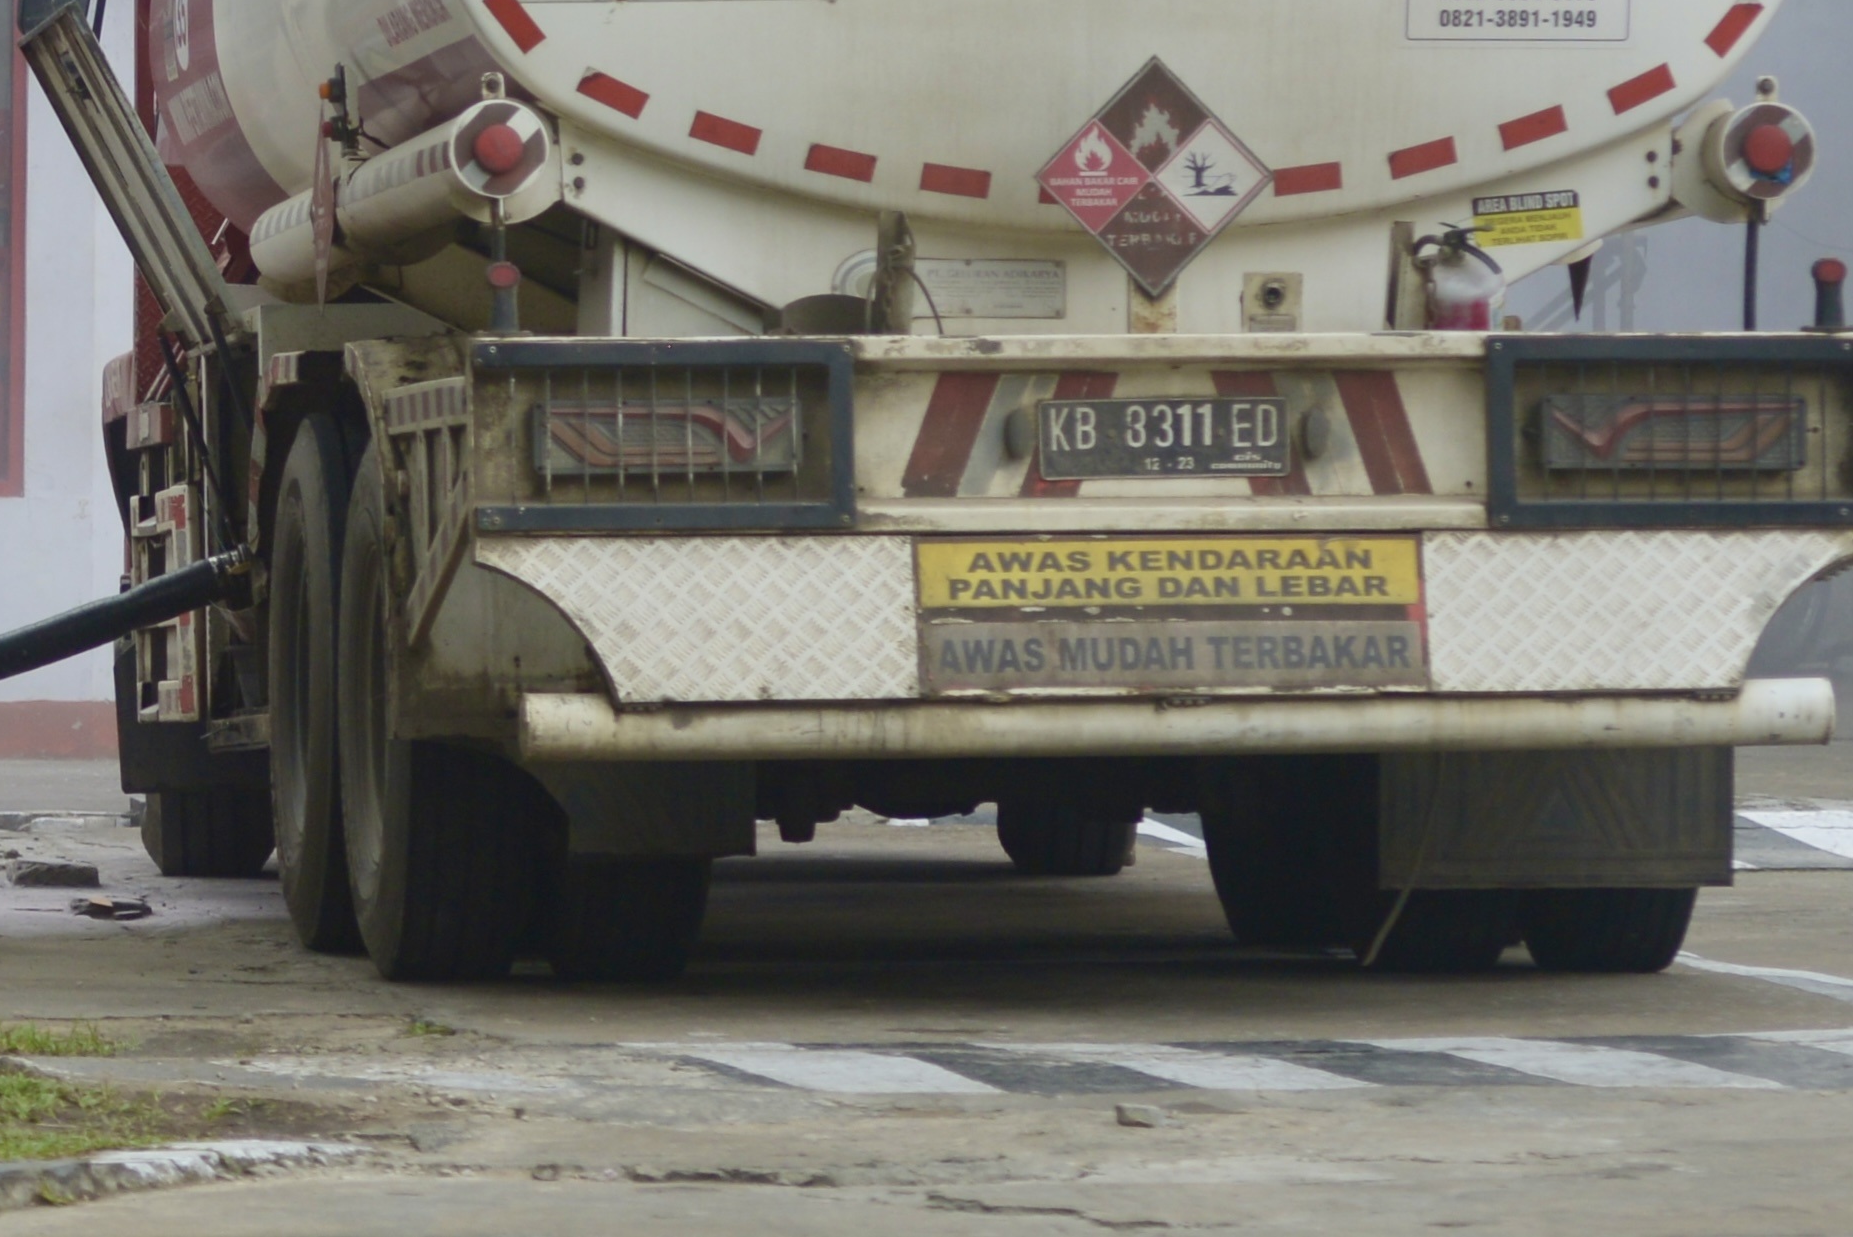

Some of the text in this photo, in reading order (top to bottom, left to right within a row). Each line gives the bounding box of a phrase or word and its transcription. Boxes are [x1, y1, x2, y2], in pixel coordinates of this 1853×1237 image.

[1439, 10, 1597, 28] 0821-3891-1949
[1070, 198, 1118, 206] TERBAKAR
[1477, 192, 1574, 214] AREA BLIND SPOT
[1050, 407, 1097, 451] KB
[1231, 403, 1278, 448] ED
[967, 549, 1372, 574] AWAS KENDARAAN
[948, 575, 1389, 601] PANJANG DAN LEBAR
[939, 632, 1411, 674] AWAS MUDAH TERBAKAR
